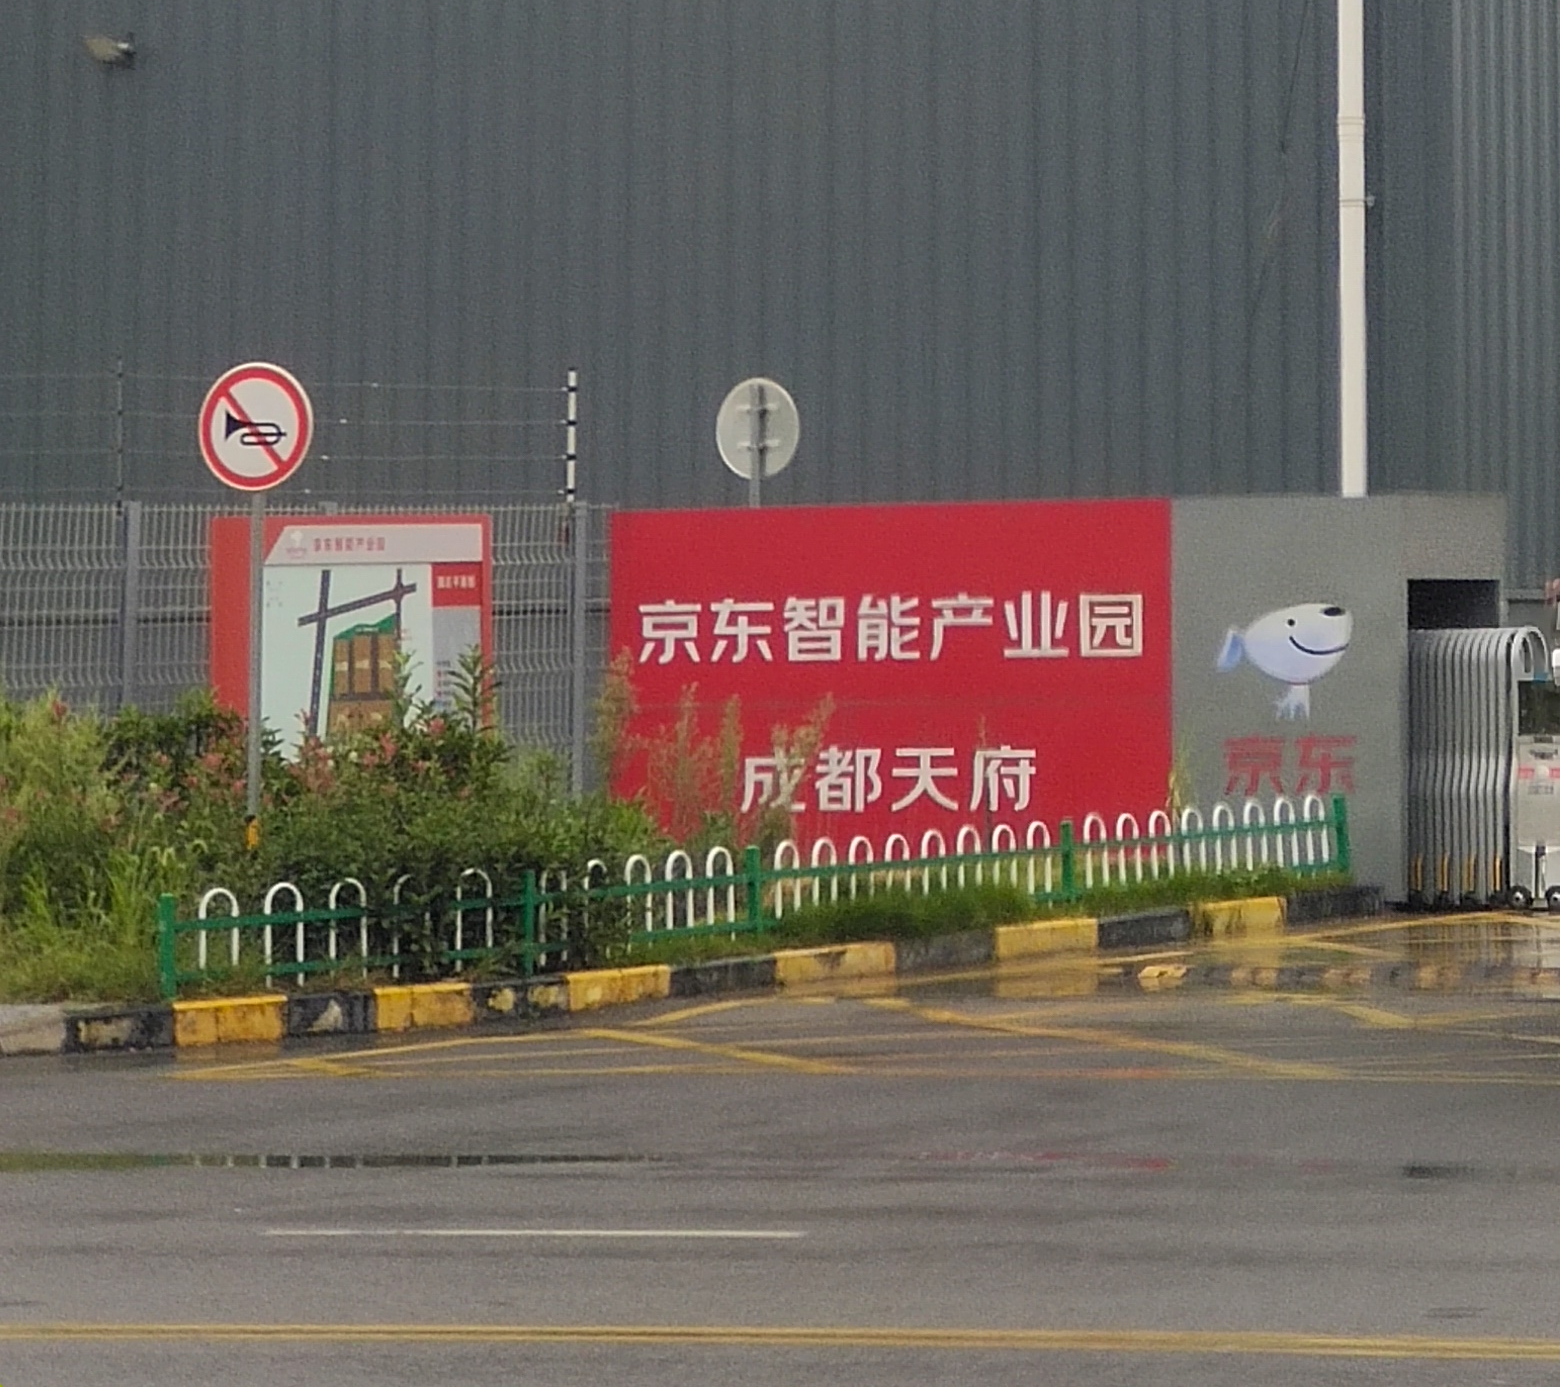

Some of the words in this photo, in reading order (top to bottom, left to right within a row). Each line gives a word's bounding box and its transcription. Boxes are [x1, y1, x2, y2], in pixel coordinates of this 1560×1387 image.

[638, 590, 1144, 663] 京东智能产业园
[740, 744, 1037, 813] 成都天府
[1222, 732, 1358, 796] 京东
